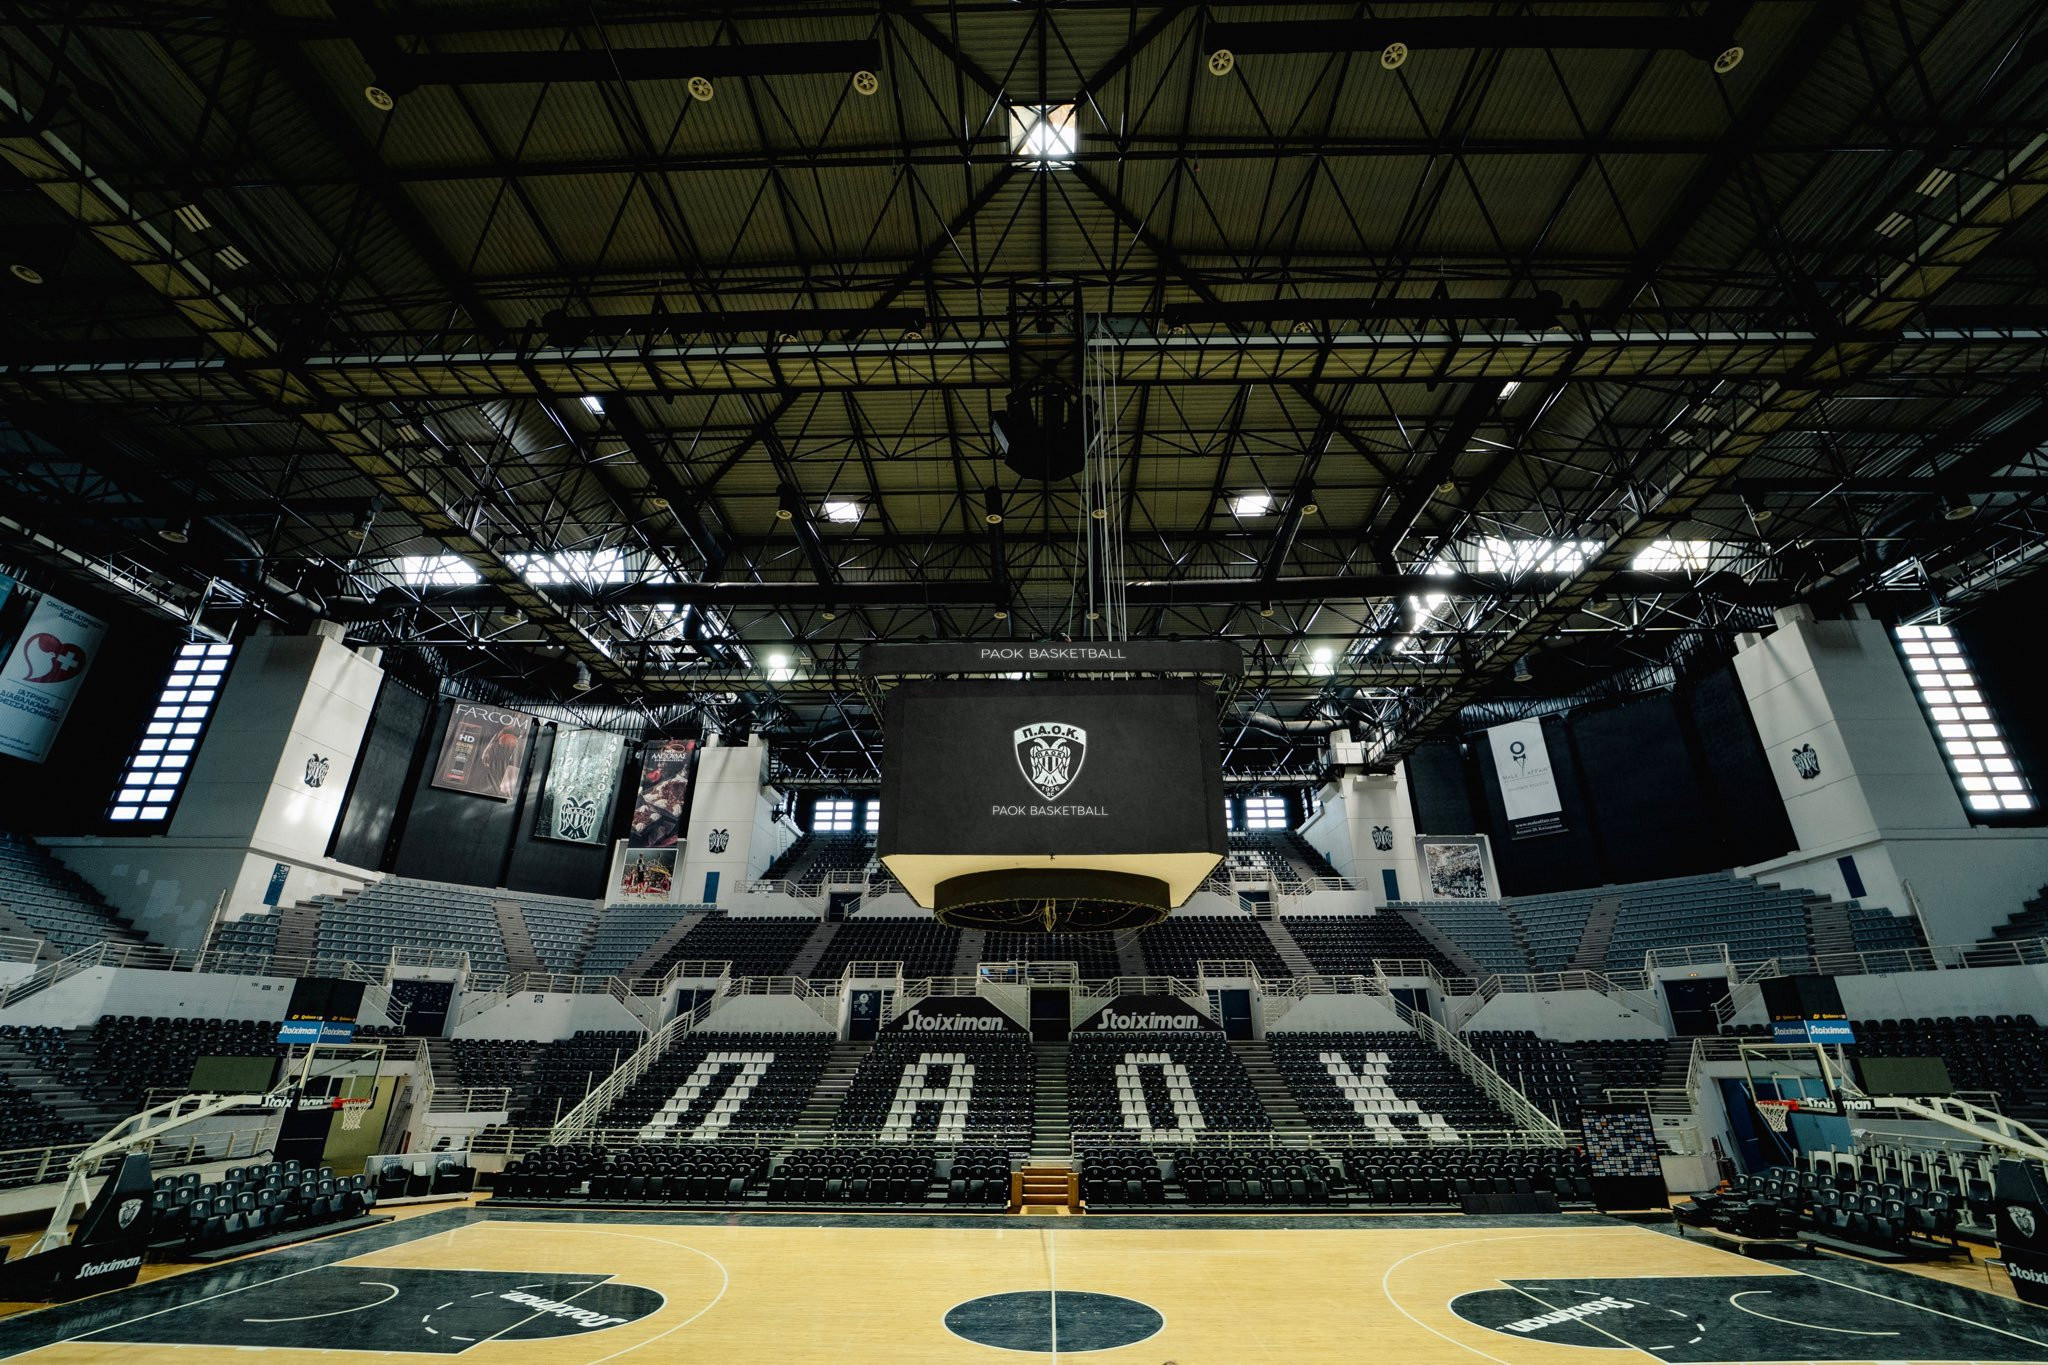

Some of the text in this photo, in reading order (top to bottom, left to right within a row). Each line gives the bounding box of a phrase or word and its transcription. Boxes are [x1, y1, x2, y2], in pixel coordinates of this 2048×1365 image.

[981, 648, 1126, 659] PAOK BASKETBALL
[456, 703, 529, 730] FARCOM
[459, 734, 475, 743] HD
[1041, 785, 1060, 793] 1926
[992, 805, 1109, 816] PAOK BASKETBALL
[902, 1008, 1004, 1032] Stoiximan
[1097, 1007, 1199, 1031] Stoiximan
[279, 1025, 318, 1035] Stoiximan
[321, 1026, 351, 1036] Stoiximan
[1774, 1026, 1805, 1036] Stoiximan
[1810, 1025, 1851, 1035] Stoiximan
[74, 1256, 142, 1280] Stoiximan
[499, 1290, 629, 1328] Stoiximan
[1503, 1296, 1636, 1333] Stoiximan
